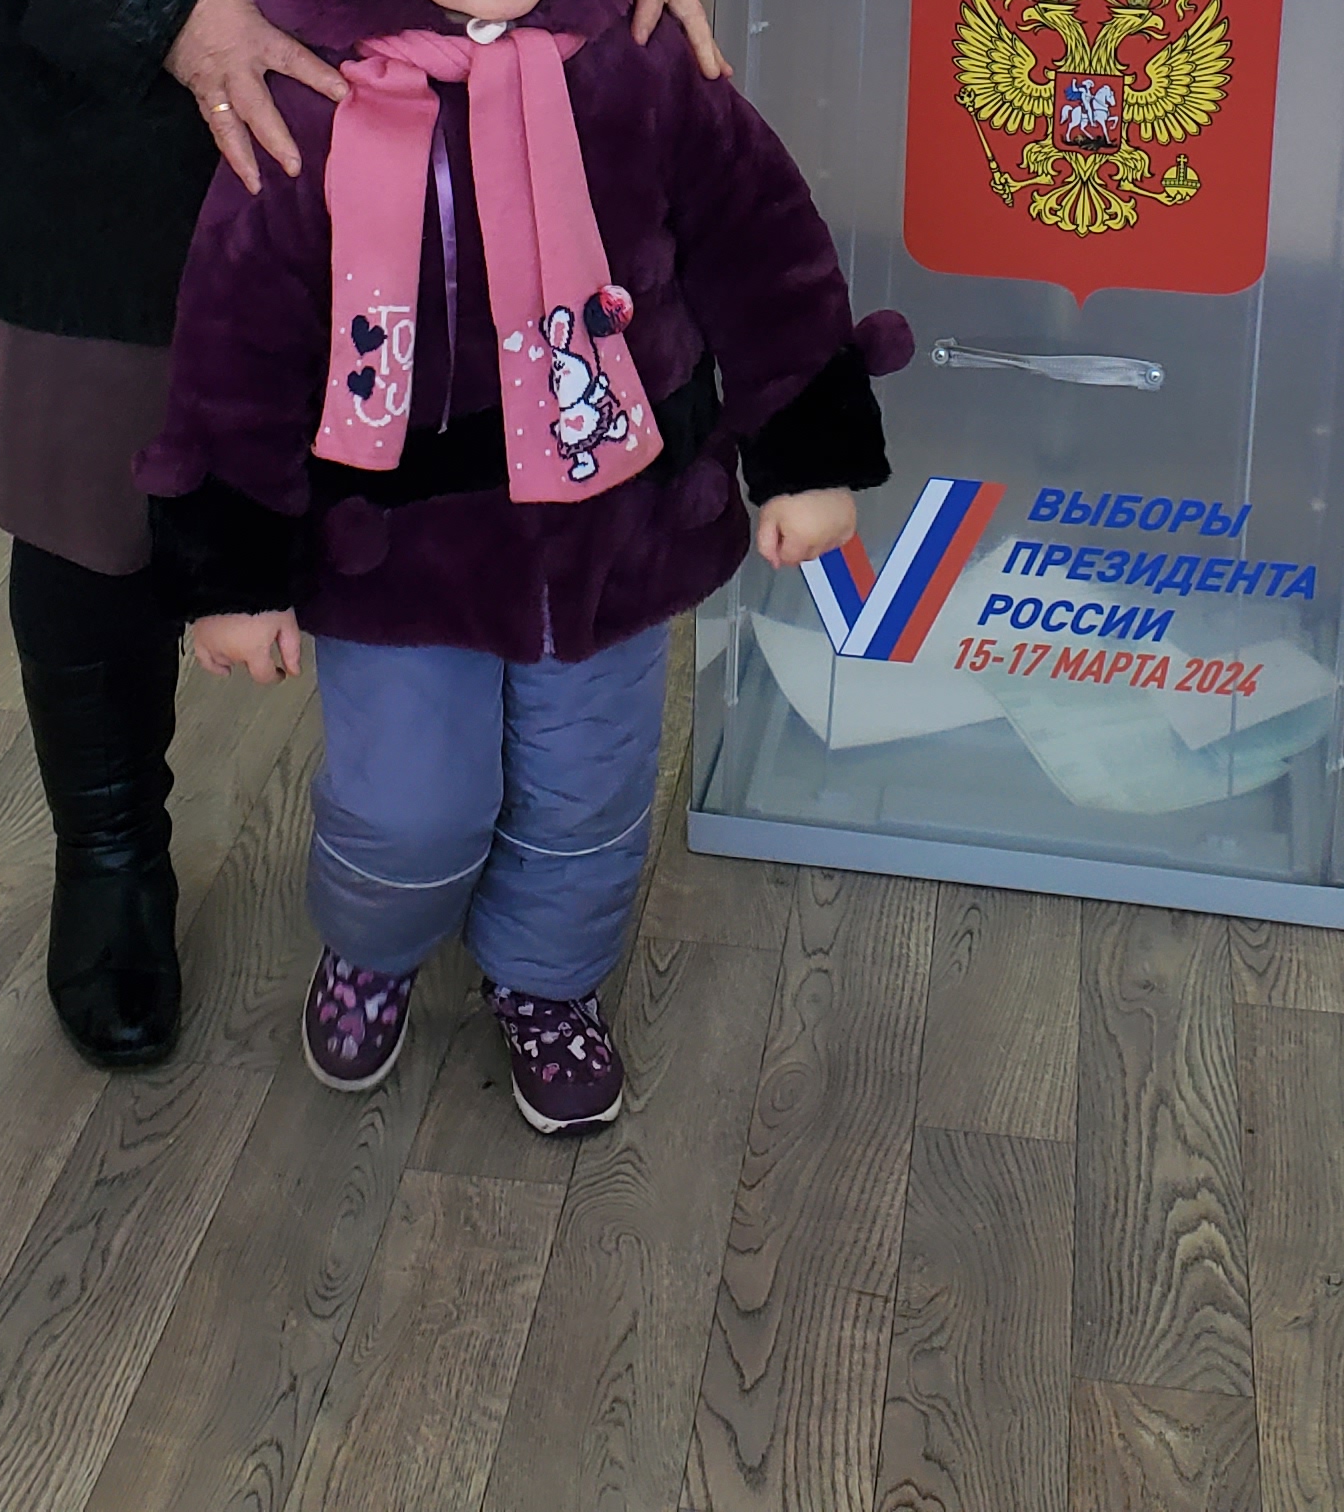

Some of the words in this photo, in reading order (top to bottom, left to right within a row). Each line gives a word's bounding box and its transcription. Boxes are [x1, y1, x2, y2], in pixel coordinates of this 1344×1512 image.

[1027, 487, 1253, 540] ВЫБОРЫ
[1001, 540, 1318, 600] ПРЕЗИДЕНТА
[977, 593, 1177, 643] РОССИИ
[954, 637, 1048, 677] 15-17
[1050, 647, 1168, 691] МАРТА
[1175, 657, 1265, 698] 2024
